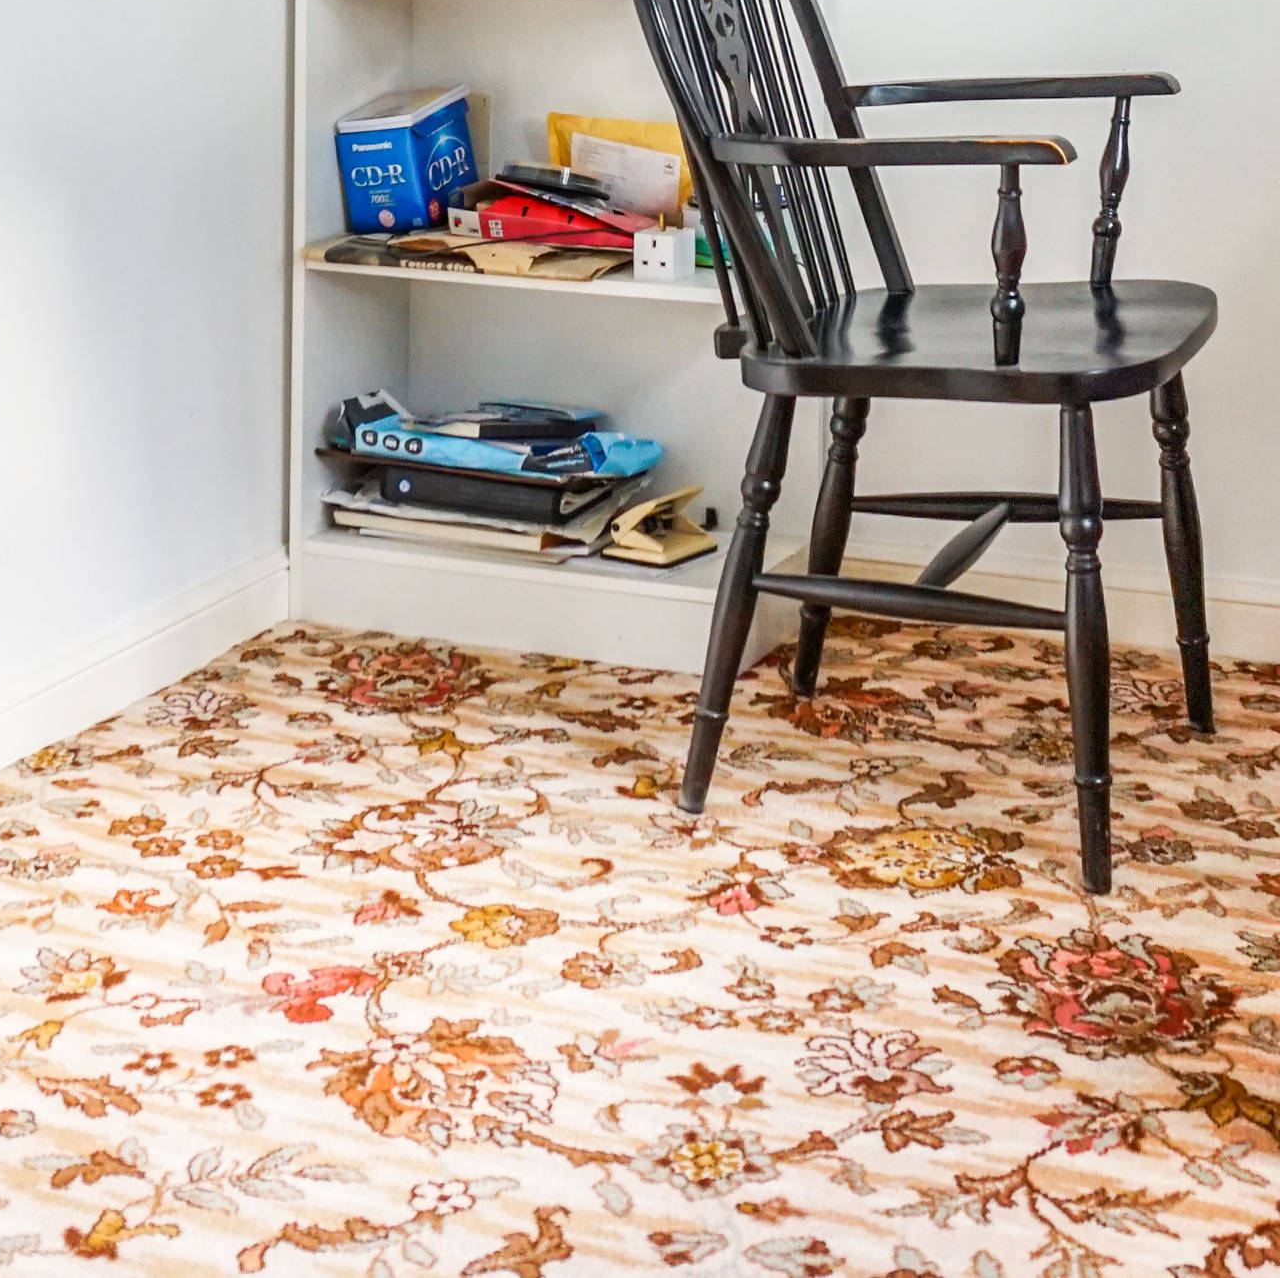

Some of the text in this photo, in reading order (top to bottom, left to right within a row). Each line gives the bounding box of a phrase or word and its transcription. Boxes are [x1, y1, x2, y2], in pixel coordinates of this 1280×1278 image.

[352, 140, 392, 152] Panasonic
[351, 164, 406, 187] CD-R
[428, 146, 470, 191] CD-R
